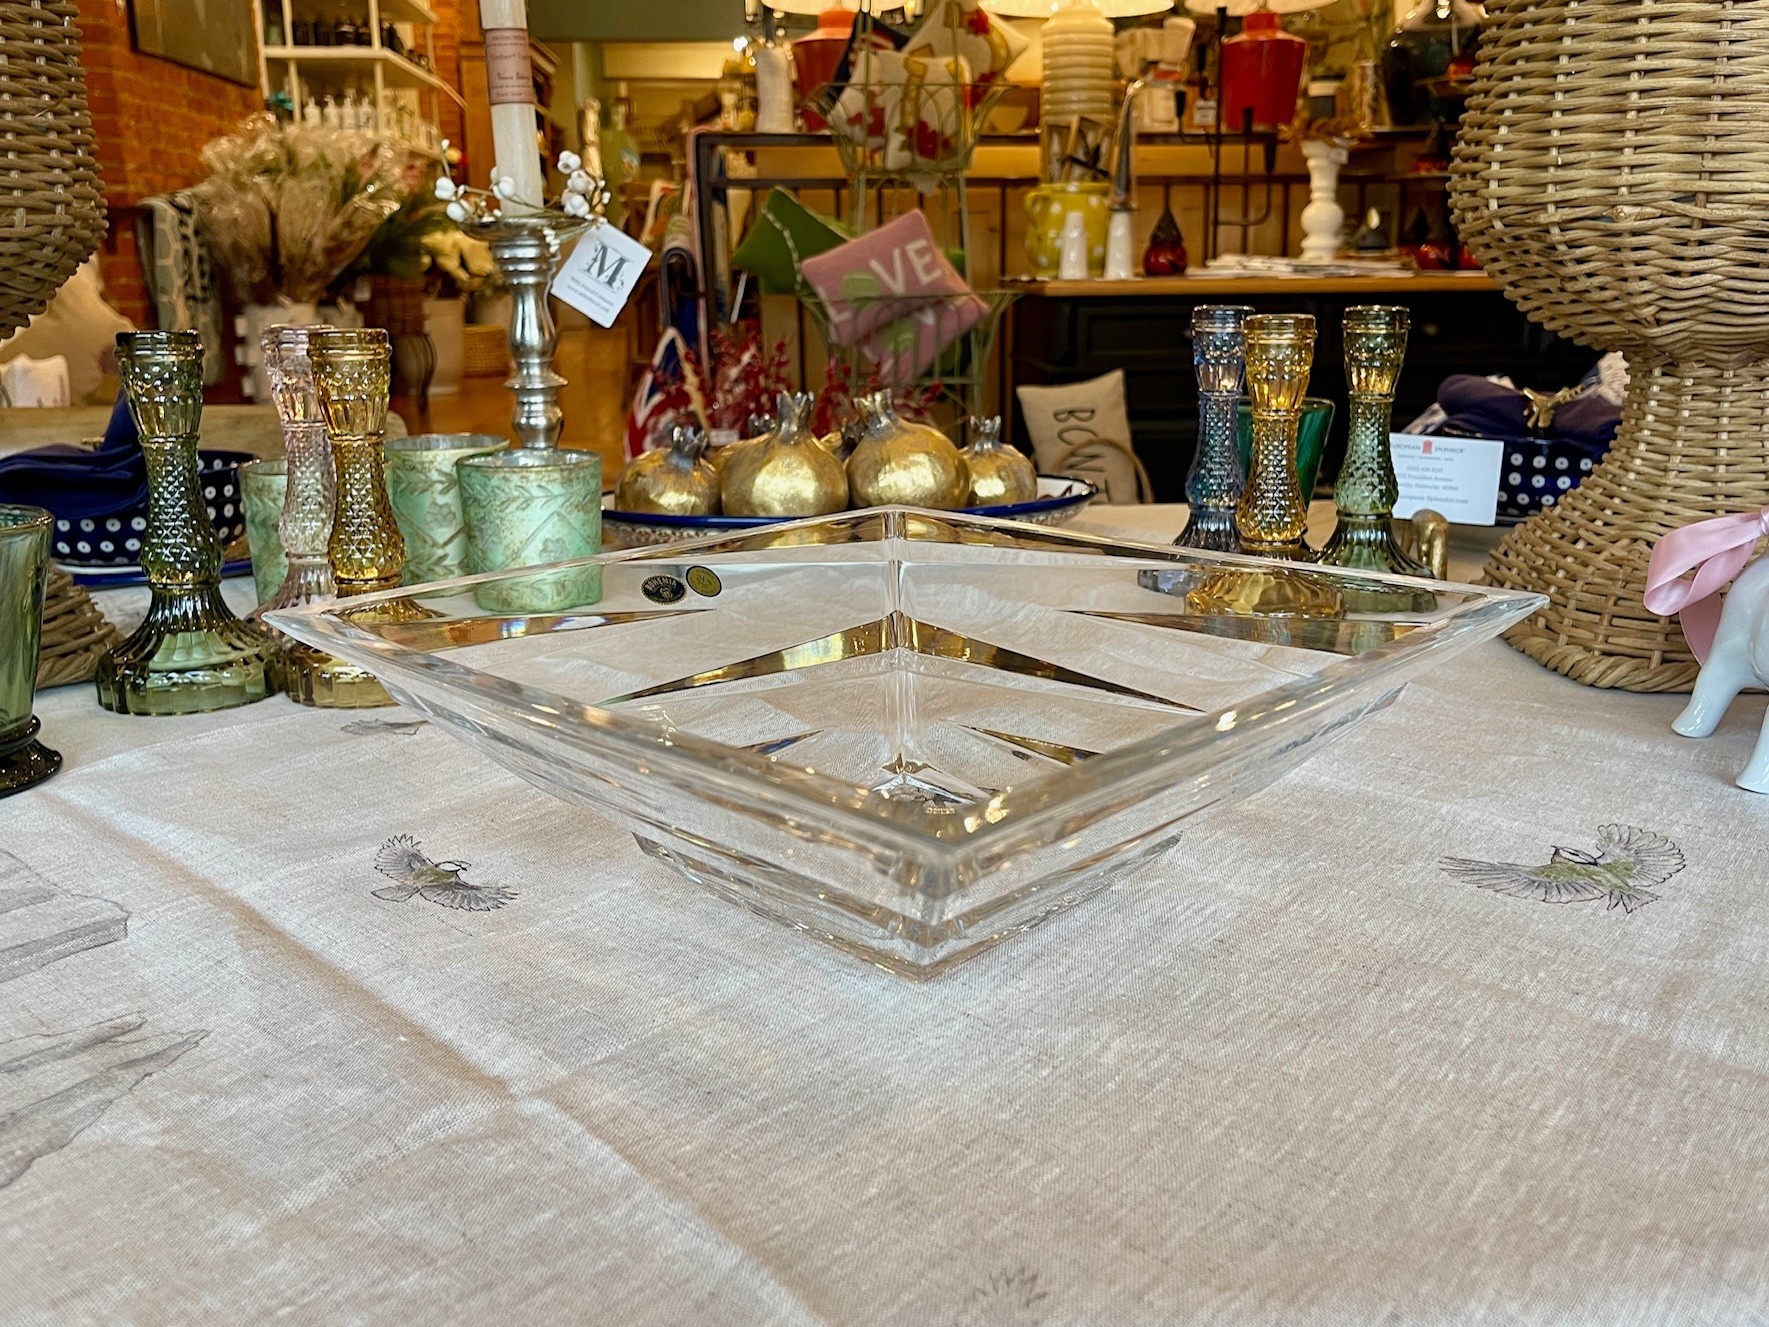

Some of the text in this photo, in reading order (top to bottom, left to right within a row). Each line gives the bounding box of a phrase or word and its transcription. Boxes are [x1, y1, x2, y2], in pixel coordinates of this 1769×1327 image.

[581, 240, 633, 291] M
[1391, 442, 1421, 451] UROPEAN
[644, 576, 677, 591] BOHEMIA
